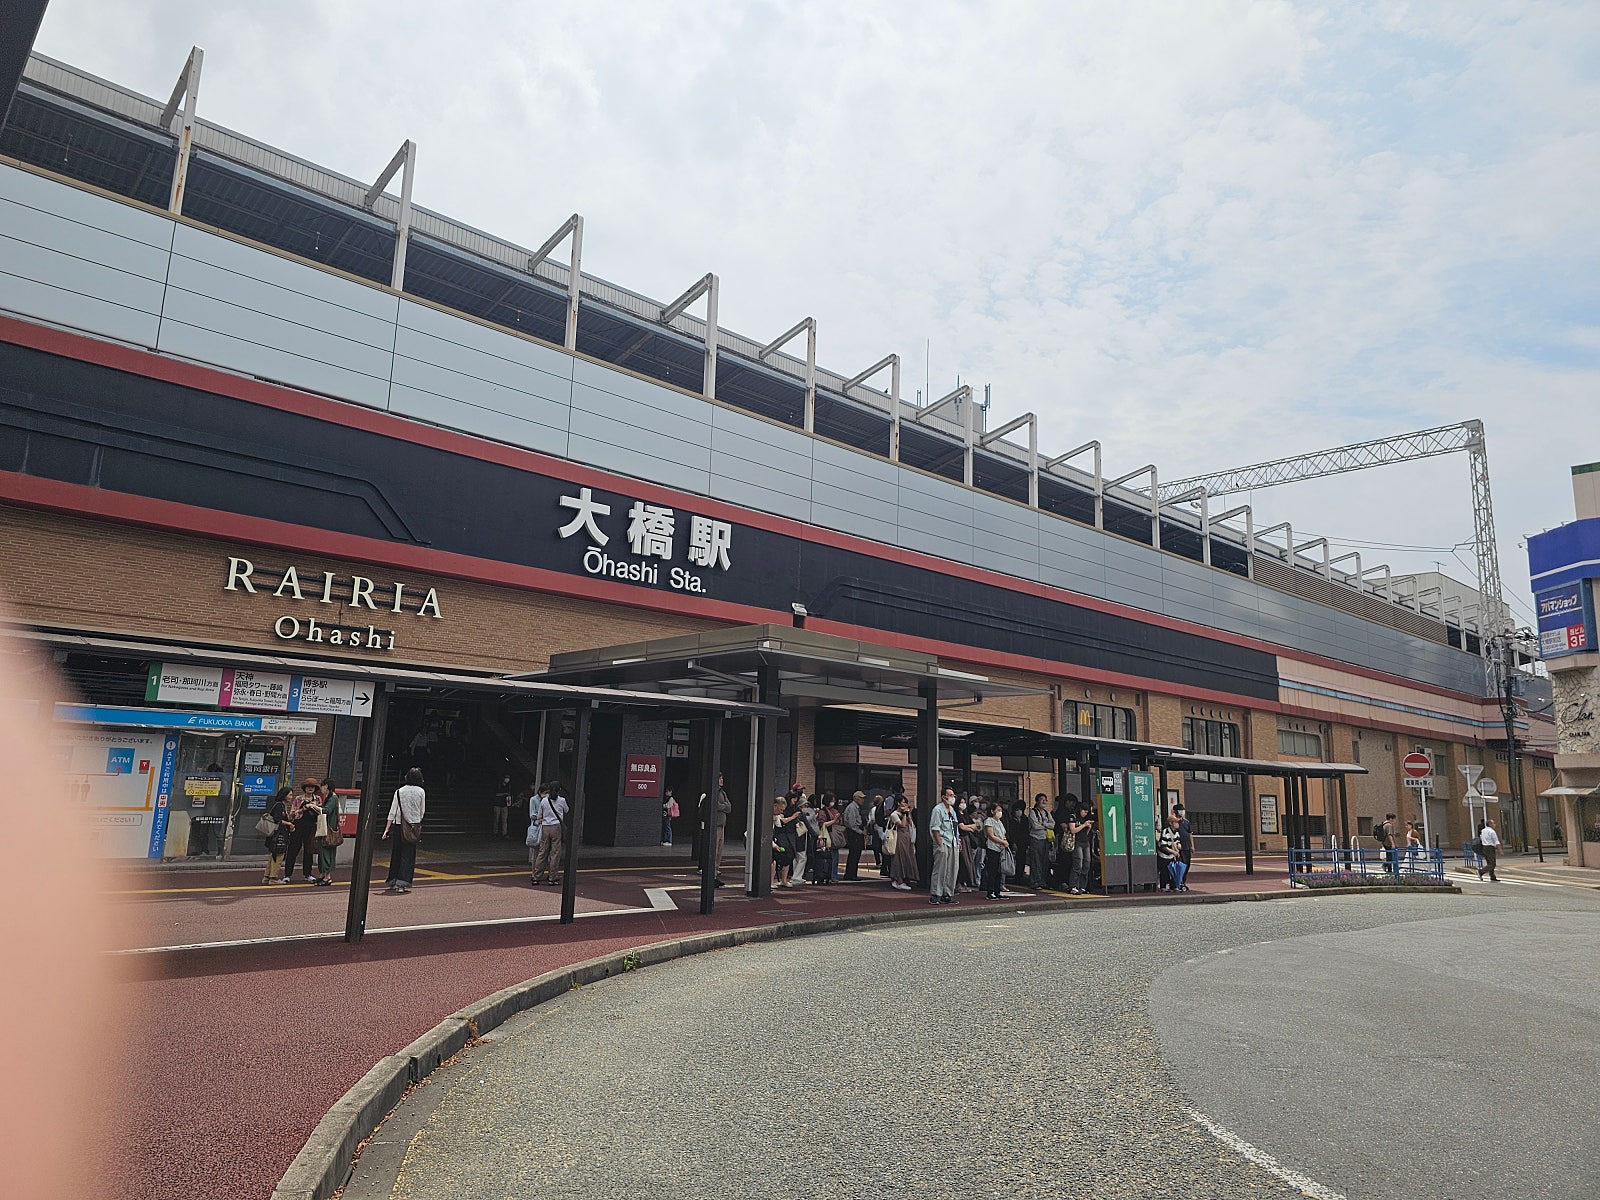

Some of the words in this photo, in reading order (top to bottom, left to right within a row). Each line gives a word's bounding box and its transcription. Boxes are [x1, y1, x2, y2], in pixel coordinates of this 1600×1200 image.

[558, 487, 732, 571] 大橋駅
[583, 546, 658, 584] Ōhashi
[670, 567, 707, 593] Sta.
[224, 556, 443, 619] RAIRIA
[1541, 594, 1578, 613] アパマンショップ
[275, 616, 395, 650] Ohashi
[1570, 634, 1585, 647] 3F
[151, 675, 157, 685] 1
[236, 672, 254, 681] 天神
[223, 682, 231, 692] 2
[303, 679, 328, 688] 博多駅
[292, 688, 299, 697] 3
[198, 718, 232, 726] FUKUOKA
[630, 763, 656, 772] 無印良品
[1108, 806, 1117, 842] 1
